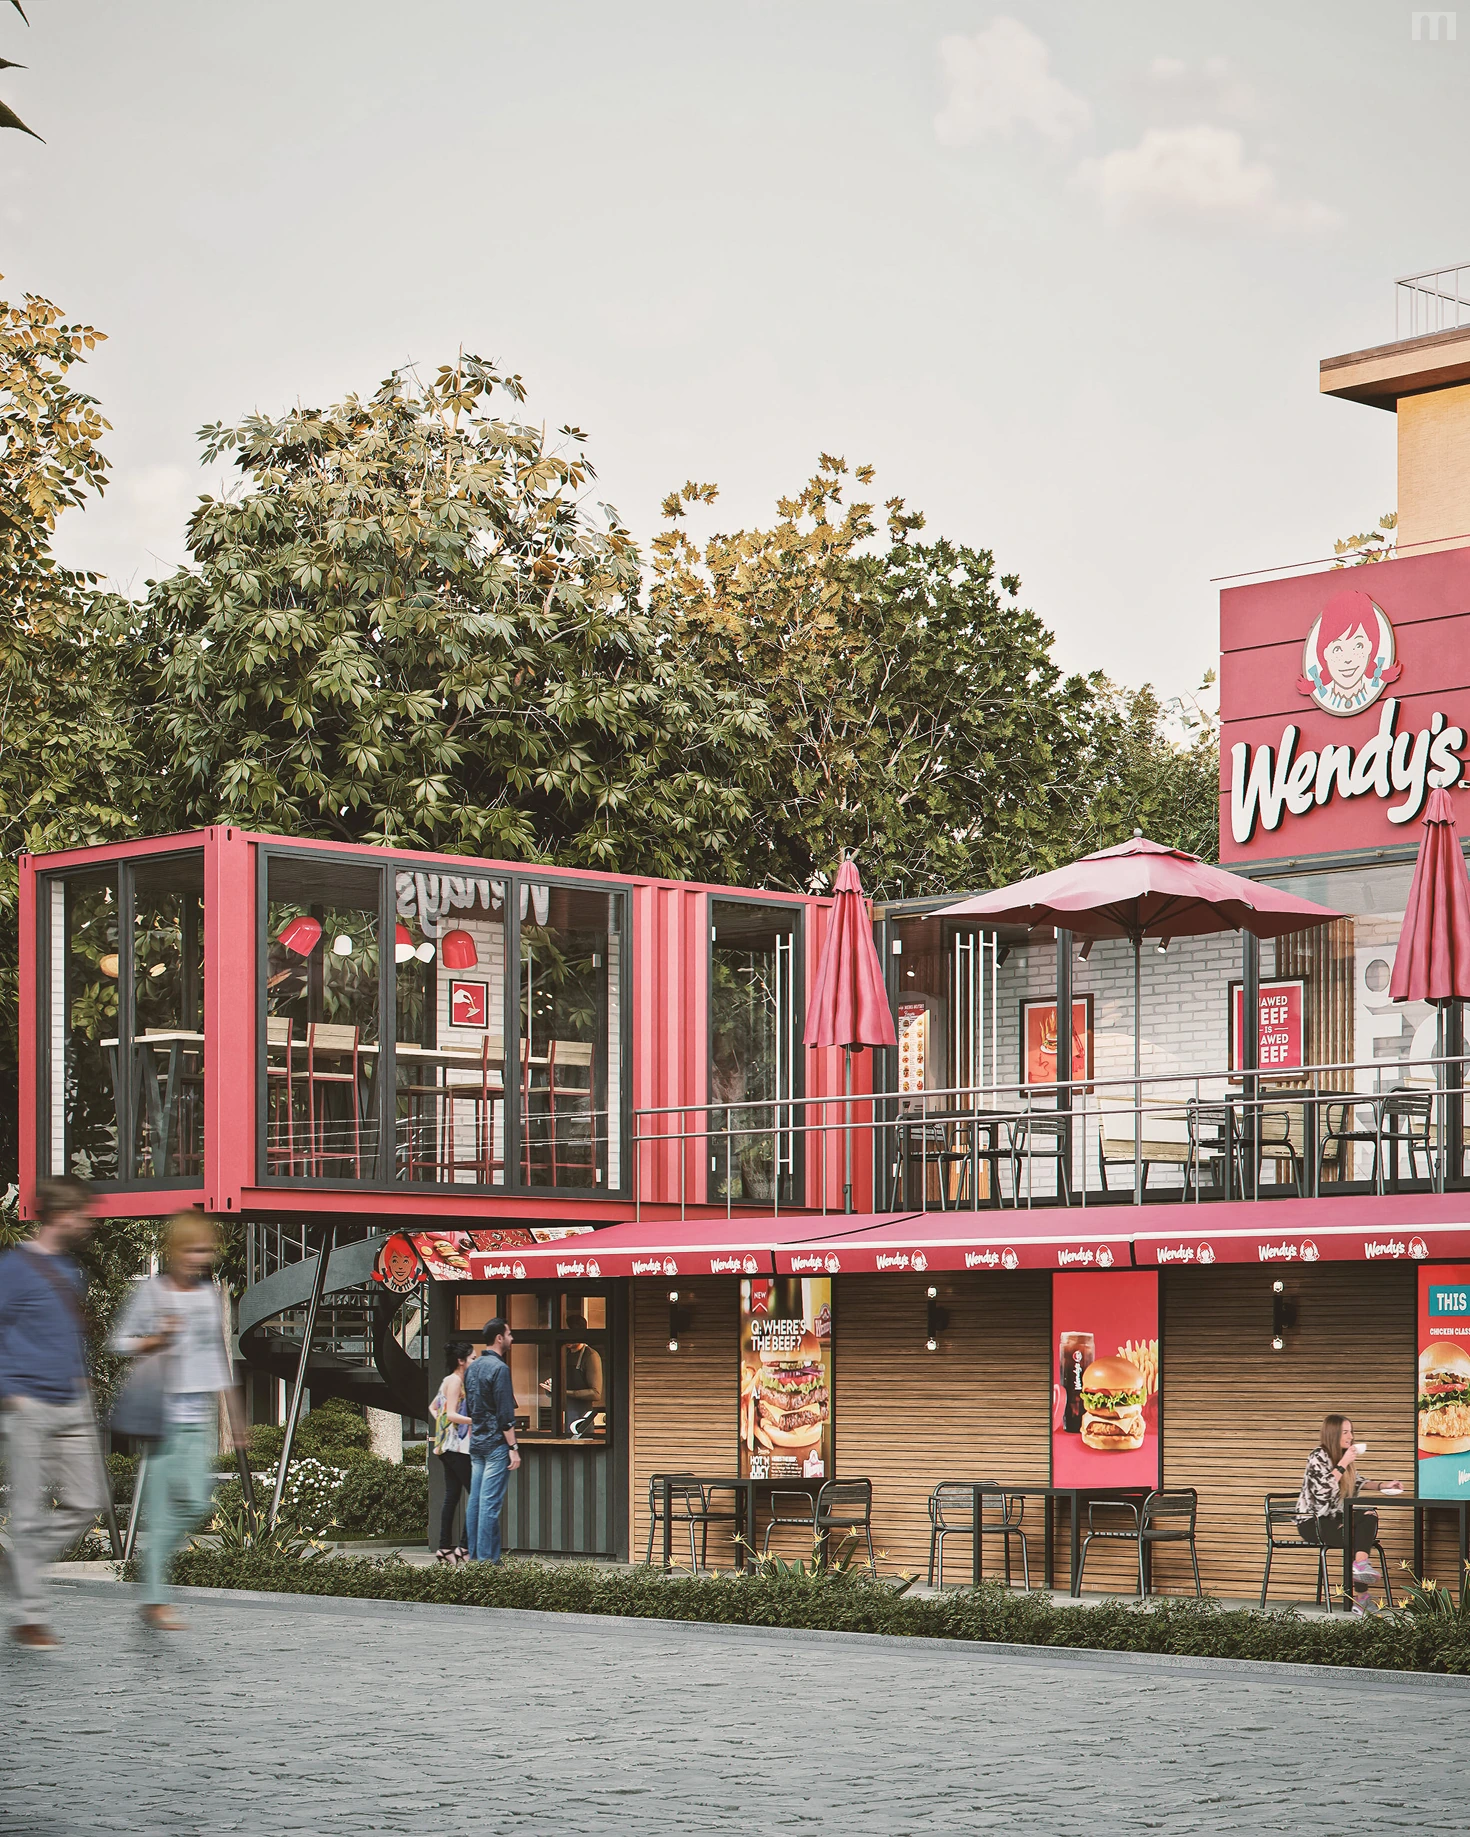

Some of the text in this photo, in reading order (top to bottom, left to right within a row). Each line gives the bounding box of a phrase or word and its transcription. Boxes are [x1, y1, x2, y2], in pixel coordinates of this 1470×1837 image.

[1231, 698, 1466, 843] Wendy's
[1259, 995, 1288, 1007] AWED
[1261, 1007, 1288, 1025] EEF
[1264, 1026, 1273, 1034] IS
[1260, 1034, 1289, 1045] AWED
[1261, 1045, 1288, 1063] EEF
[1058, 1247, 1095, 1266] Wendy's
[1157, 1244, 1194, 1263] Wendy's
[1258, 1242, 1298, 1261] Wendy's
[1365, 1239, 1406, 1259] Wendy's
[632, 1258, 661, 1275] Wendy's
[711, 1256, 741, 1274] Wendy's
[791, 1254, 823, 1272] Wendy's
[876, 1252, 909, 1270] Wendy's
[965, 1250, 1000, 1268] Wendy's
[484, 1262, 511, 1278] Wendy's
[557, 1260, 584, 1277] Wendy's
[754, 1291, 767, 1299] NEW
[1436, 1292, 1467, 1311] THIS
[751, 1319, 762, 1335] Q:
[763, 1319, 806, 1335] WHERE'S
[1429, 1327, 1454, 1335] CHICKEN
[750, 1335, 801, 1351] THE BEEF?
